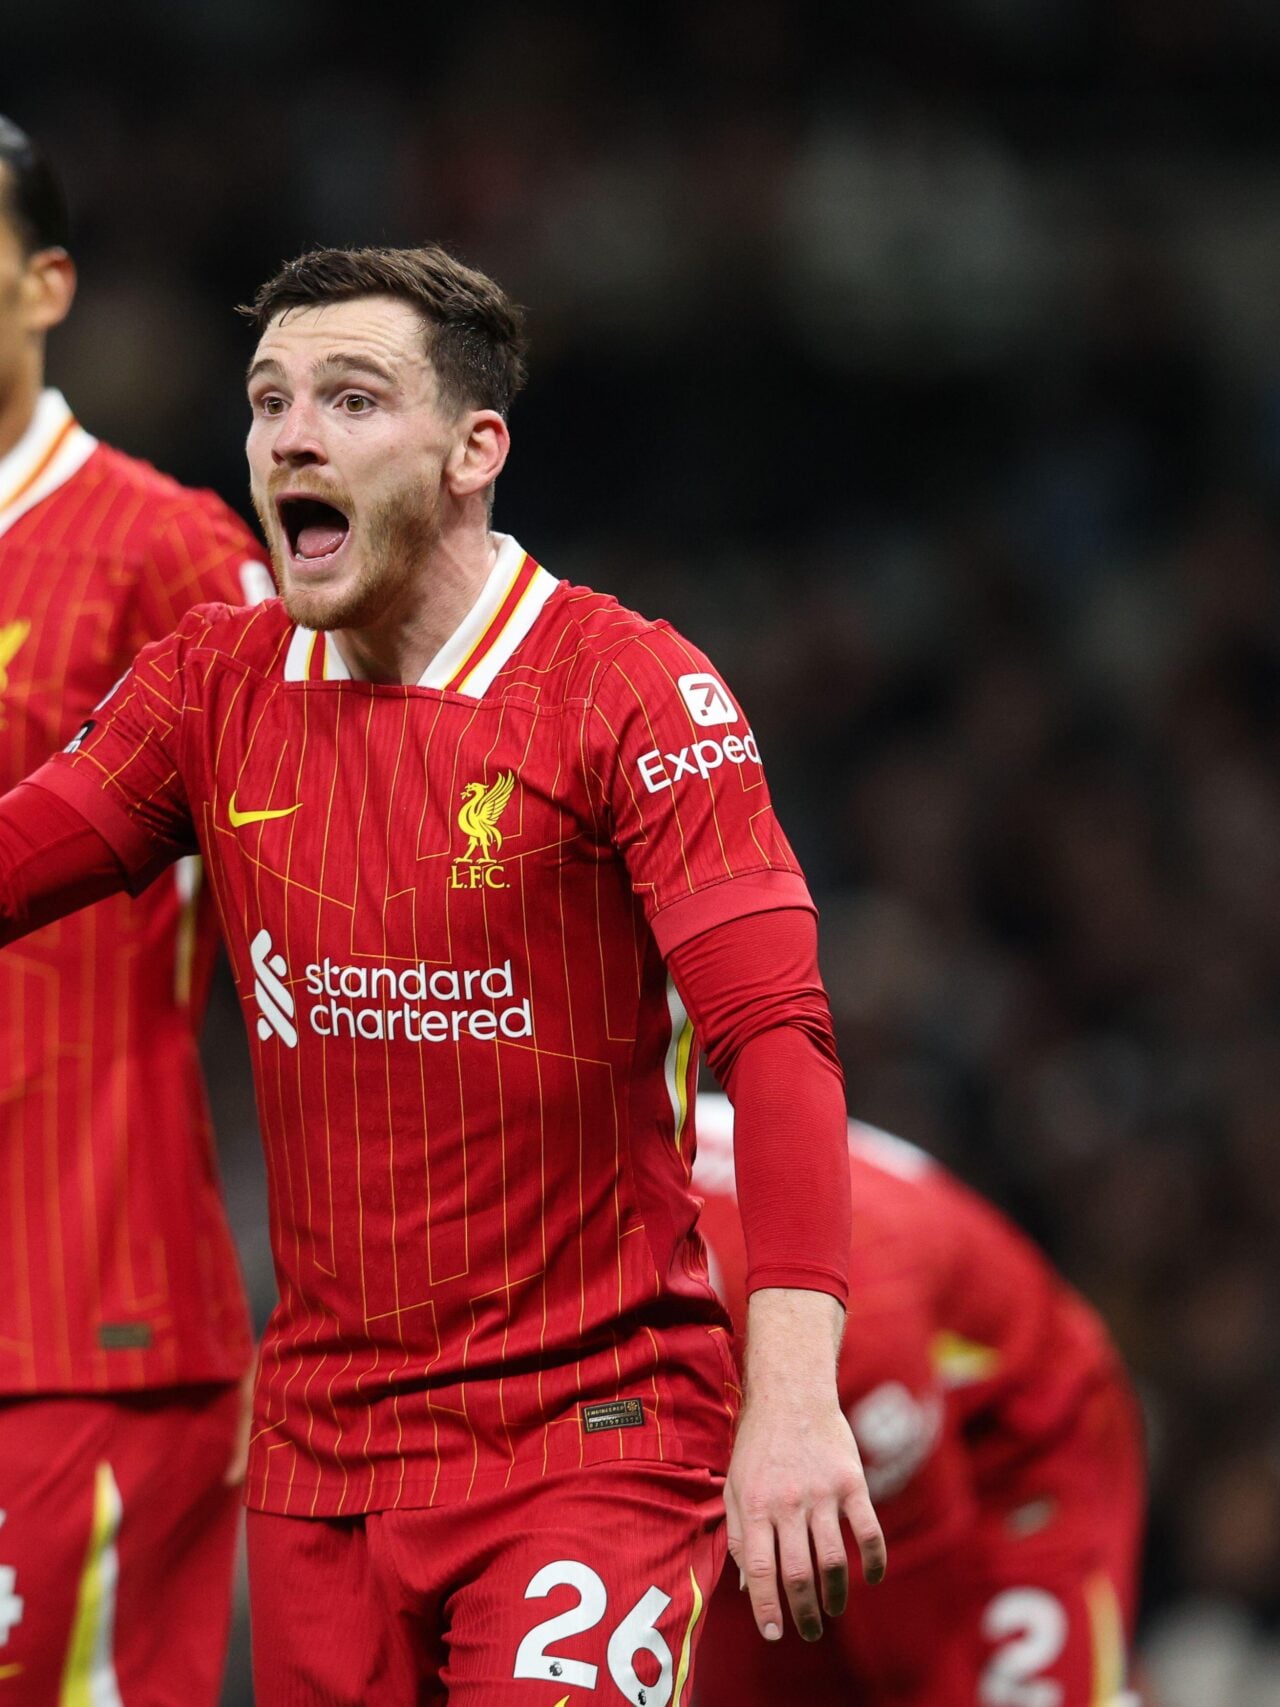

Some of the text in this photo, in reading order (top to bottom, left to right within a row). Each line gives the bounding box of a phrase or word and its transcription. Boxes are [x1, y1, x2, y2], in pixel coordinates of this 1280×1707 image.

[451, 865, 511, 889] L.F.C.
[305, 957, 514, 1000] standard
[309, 998, 533, 1042] chartered
[513, 1559, 673, 1707] 26
